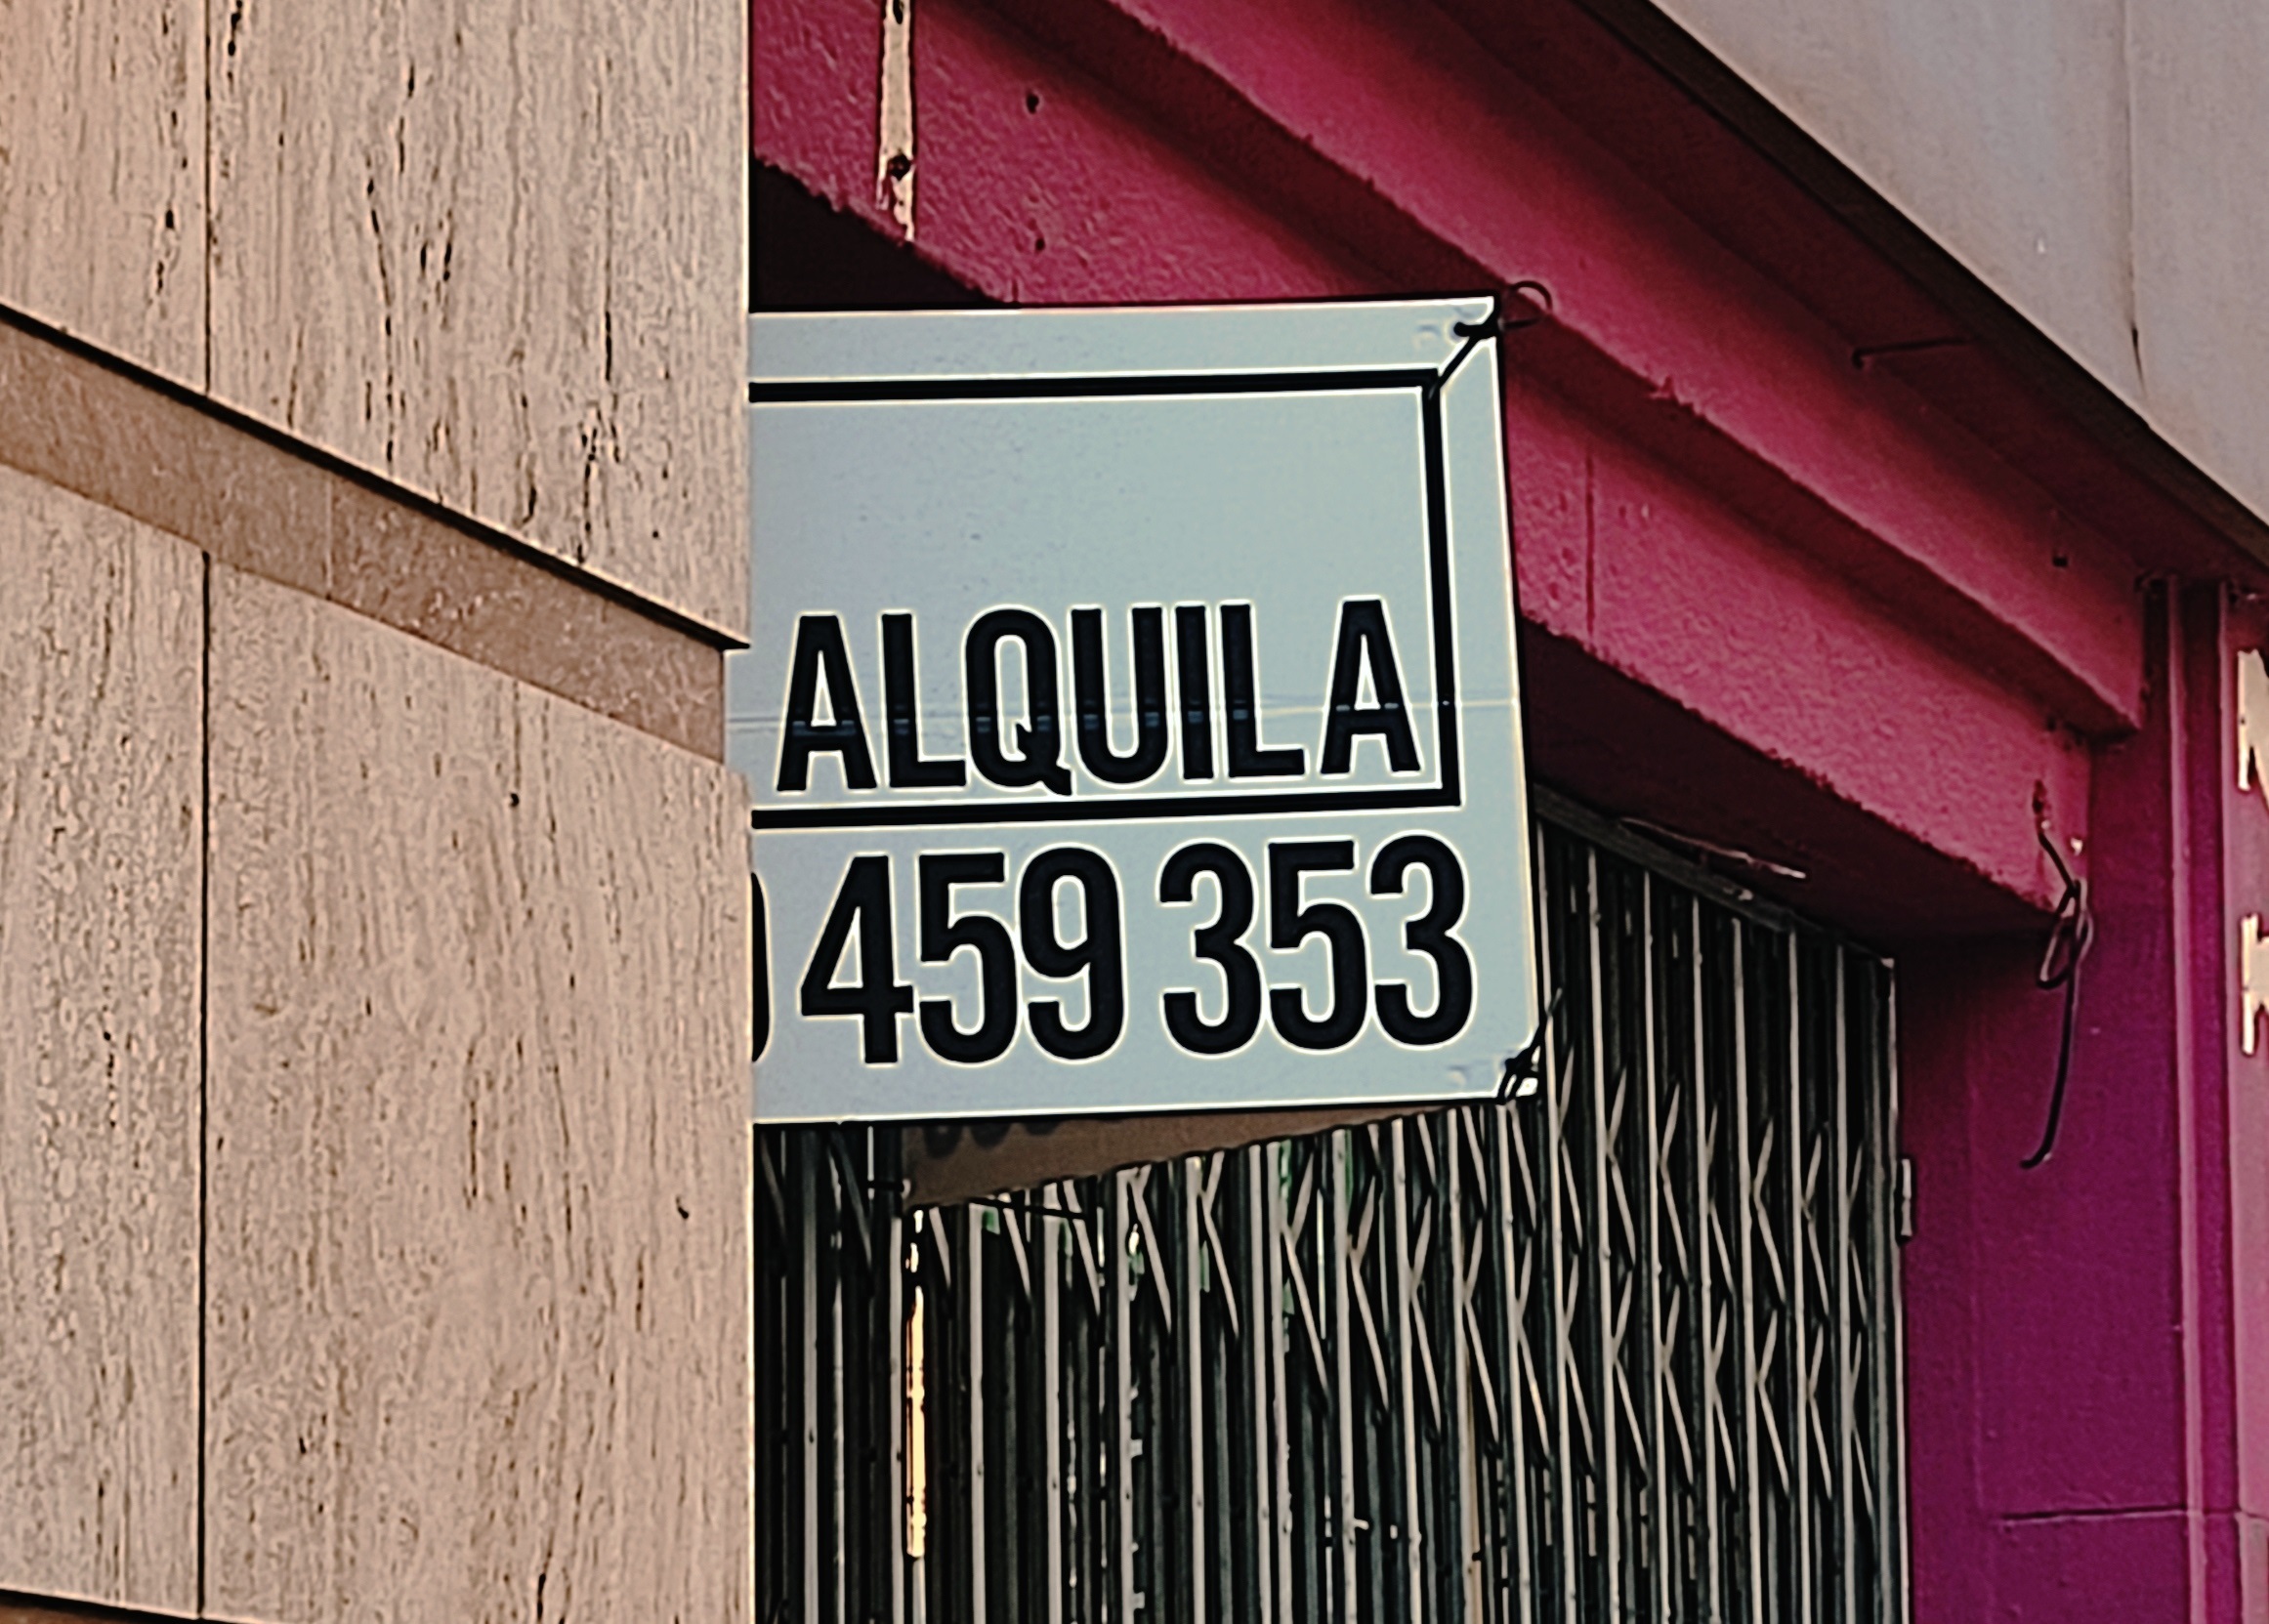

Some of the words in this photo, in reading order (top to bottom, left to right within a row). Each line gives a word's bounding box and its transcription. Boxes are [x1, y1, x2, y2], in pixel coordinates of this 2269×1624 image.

[776, 598, 1421, 797] ALQUILA
[799, 847, 1125, 1064] 459
[1158, 835, 1474, 1056] 353
